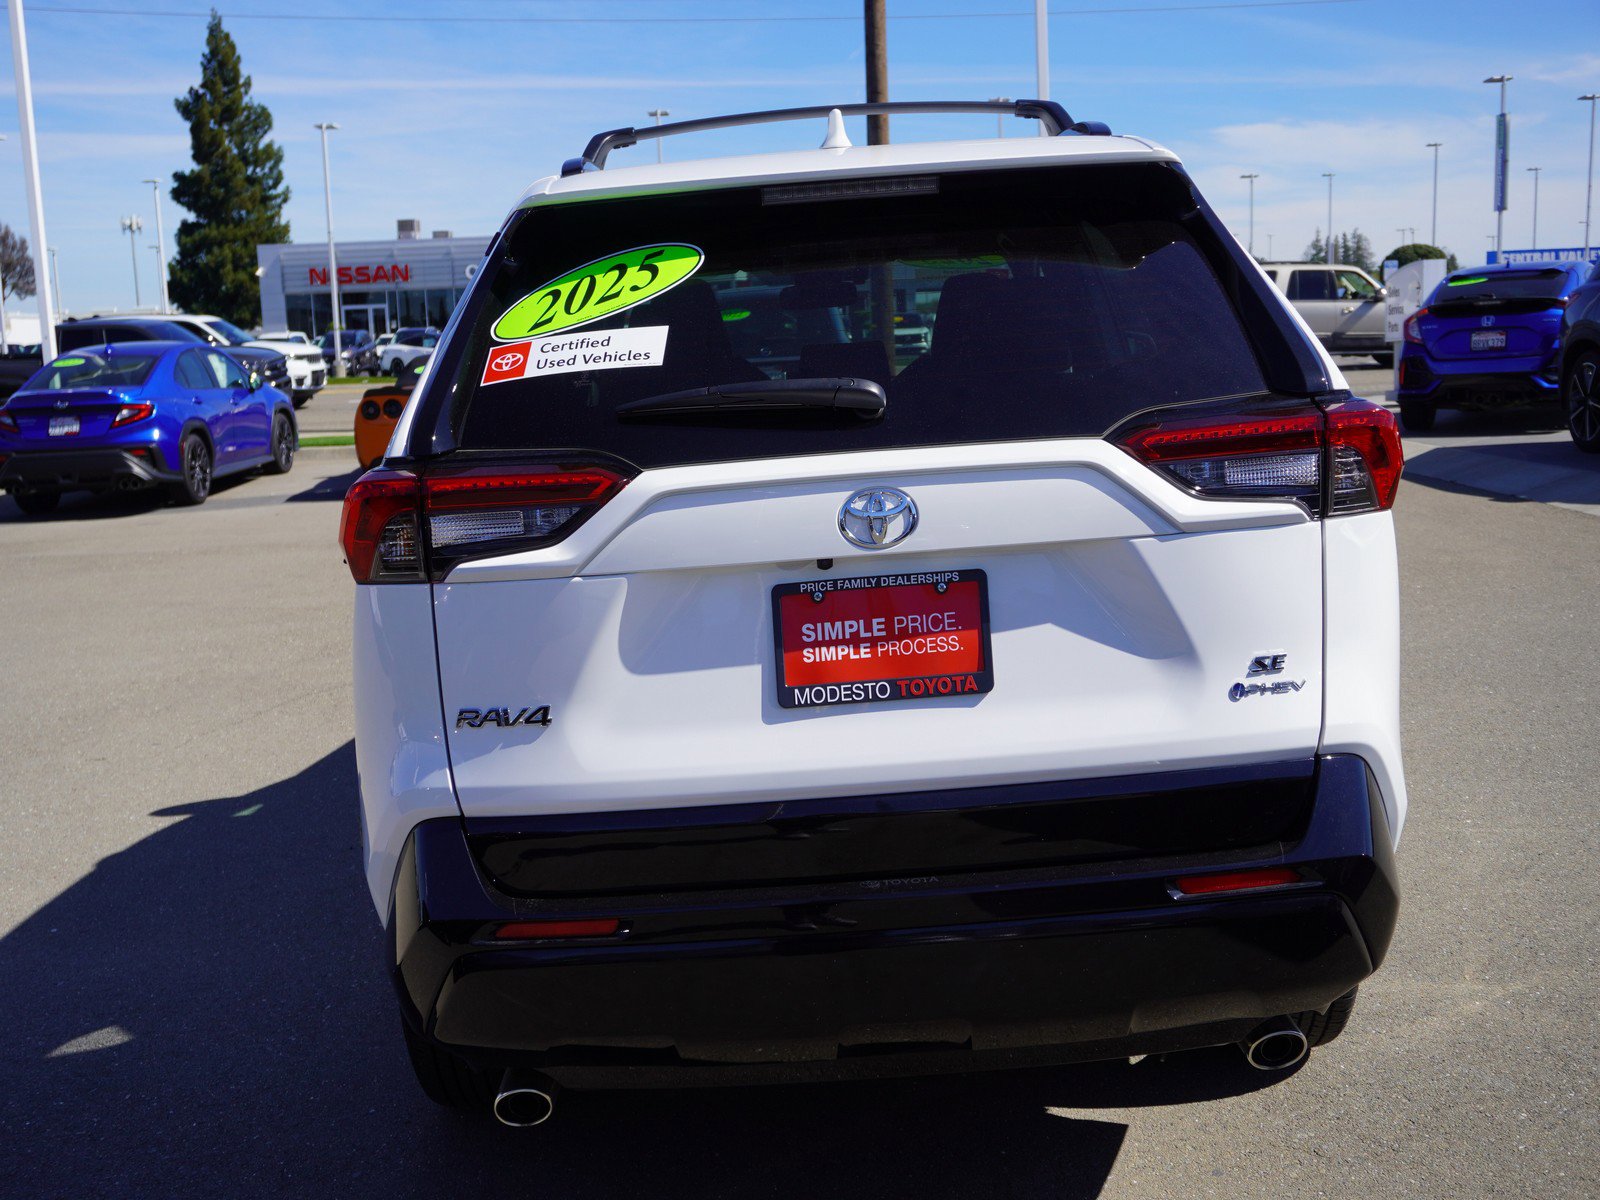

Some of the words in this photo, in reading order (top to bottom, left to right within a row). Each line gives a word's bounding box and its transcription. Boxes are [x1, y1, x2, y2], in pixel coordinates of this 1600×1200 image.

[308, 264, 409, 286] NSSAN
[527, 250, 665, 333] 2025
[1388, 305, 1404, 315] Service
[540, 336, 611, 354] Certified
[536, 355, 577, 370] Used
[583, 350, 651, 365] Vehicles
[800, 581, 834, 593] PRICE
[837, 576, 878, 590] FAMILY
[880, 572, 960, 587] DEALERSHIPS
[801, 618, 886, 643] SIMPLE
[894, 612, 962, 635] PRICE.
[802, 643, 871, 664] SIMPLE
[877, 636, 964, 658] PROCESS.
[1247, 654, 1287, 674] SE
[794, 682, 890, 705] MODESTO
[897, 675, 978, 697] TOYOTA
[456, 705, 552, 728] RAV4
[883, 876, 939, 886] TOYOTA
